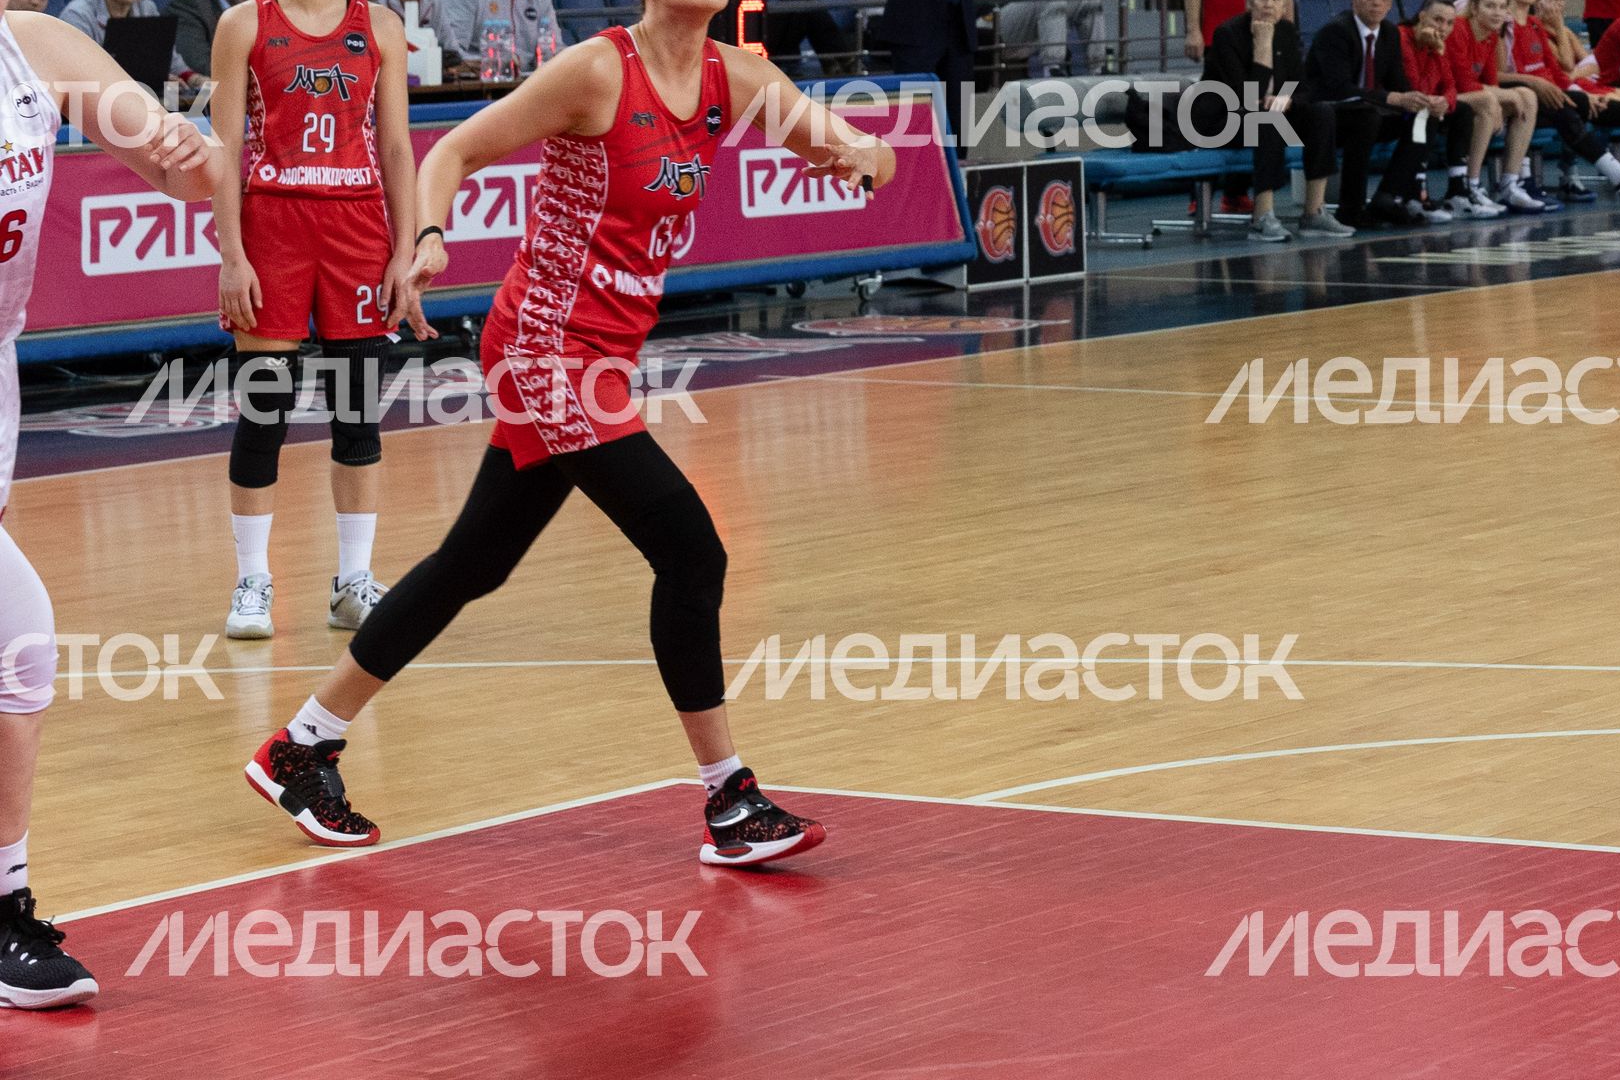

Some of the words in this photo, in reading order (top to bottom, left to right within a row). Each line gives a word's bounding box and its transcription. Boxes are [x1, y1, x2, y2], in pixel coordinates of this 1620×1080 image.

[302, 112, 336, 153] 29
[277, 165, 372, 187] МОСИНЖПРОЕКТ
[90, 198, 221, 264] PAR
